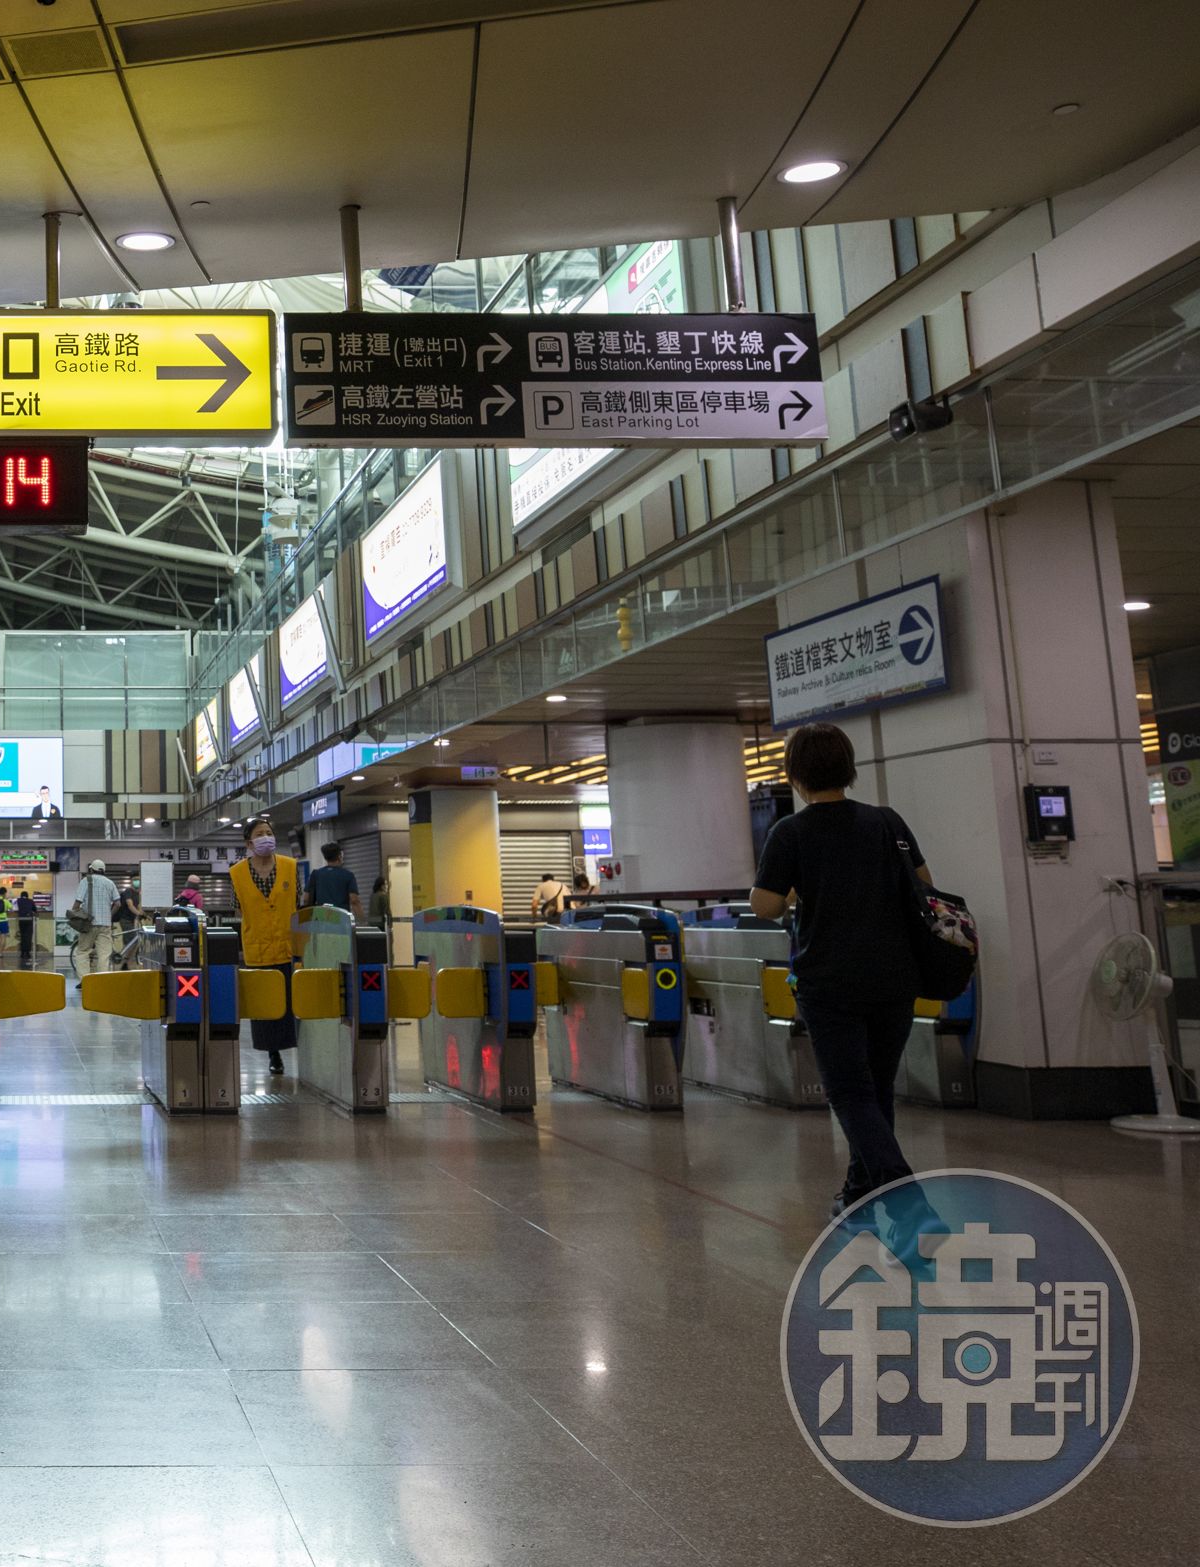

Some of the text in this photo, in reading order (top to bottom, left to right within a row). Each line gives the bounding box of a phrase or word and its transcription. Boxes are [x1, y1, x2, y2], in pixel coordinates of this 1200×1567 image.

[54, 332, 140, 357] 高鐵路
[338, 332, 391, 357] 捷運
[540, 342, 558, 351] BUS
[54, 359, 142, 373] Gaotie Rd.
[339, 360, 374, 373] MRT
[403, 355, 444, 368] Exit 1
[574, 358, 597, 371] Bus
[695, 358, 744, 374] Express
[746, 357, 772, 371] Line
[0, 391, 41, 416] Exit
[341, 384, 464, 410] 高鐵左營站
[580, 390, 770, 415] 高鐵側東區停車場
[342, 413, 473, 428] HSR Zuoying Station
[581, 415, 700, 431] East Parking Lot
[5, 456, 50, 506] 14
[775, 620, 894, 681] 鐵道檔案文物室
[777, 685, 799, 699] Railway
[801, 679, 824, 692] Archive
[831, 669, 854, 684] Culture
[855, 665, 873, 677] relics
[873, 658, 896, 671] Room
